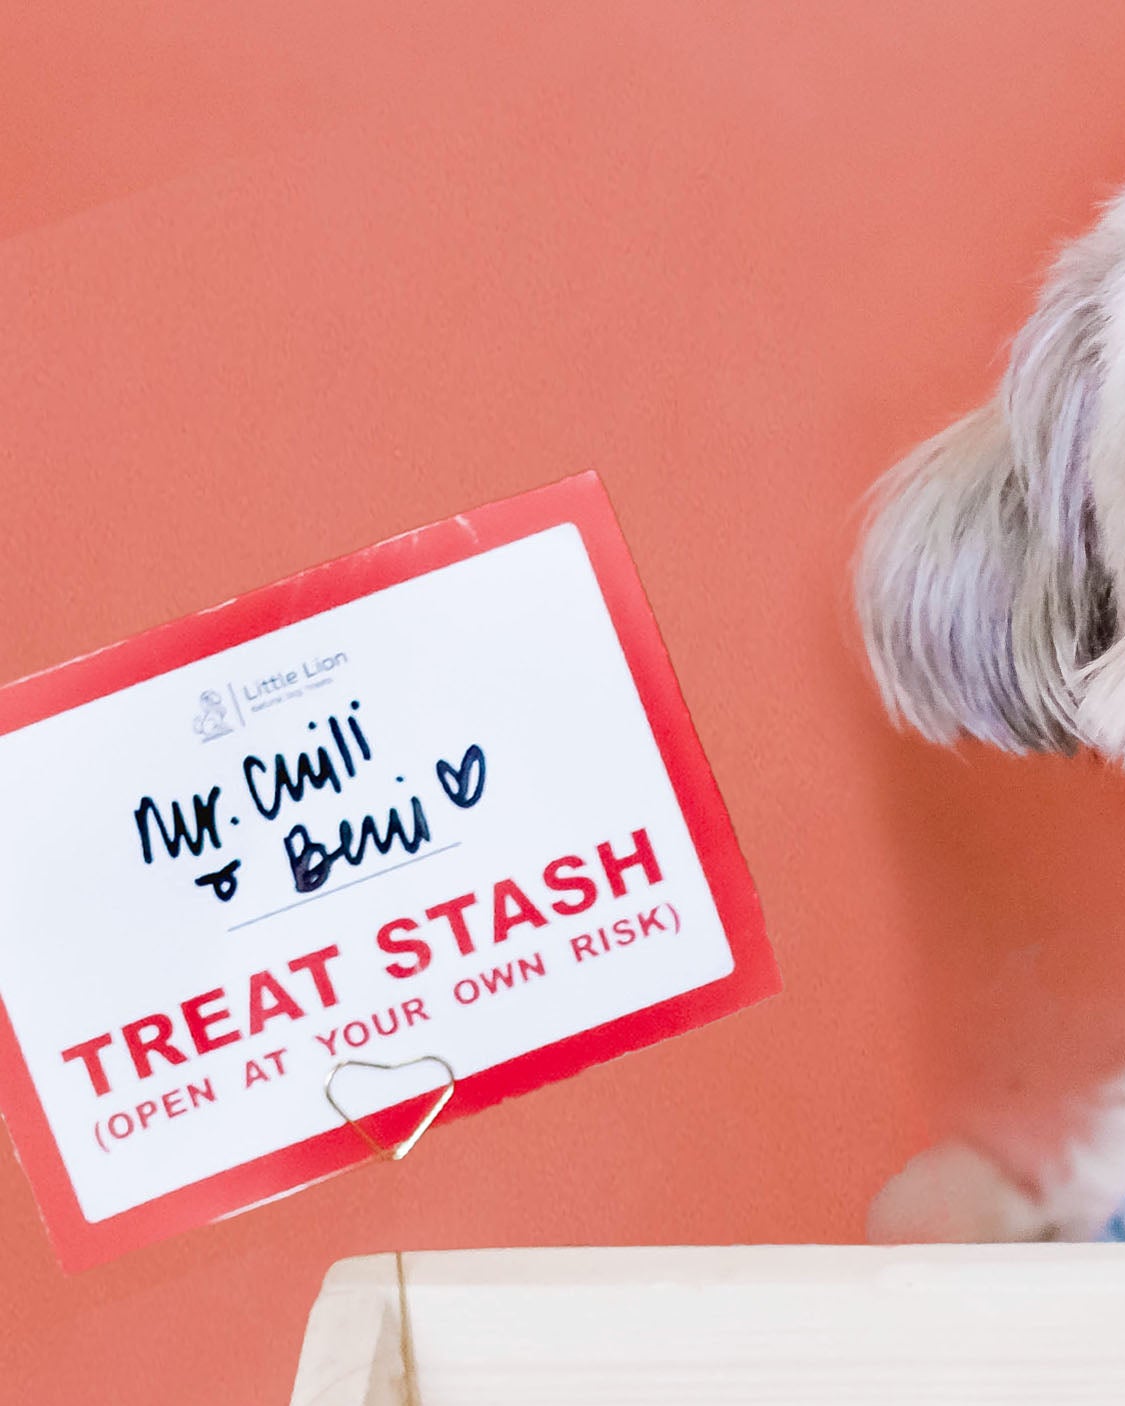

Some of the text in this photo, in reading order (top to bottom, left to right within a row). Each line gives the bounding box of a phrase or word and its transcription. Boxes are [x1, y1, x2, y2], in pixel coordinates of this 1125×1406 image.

[243, 669, 298, 701] Little
[302, 651, 349, 679] Lion
[132, 786, 240, 863] Mr.
[61, 827, 664, 1097] TREAT STASH
[94, 903, 681, 1153] (OPEN AT YOUR OWN RISK)
